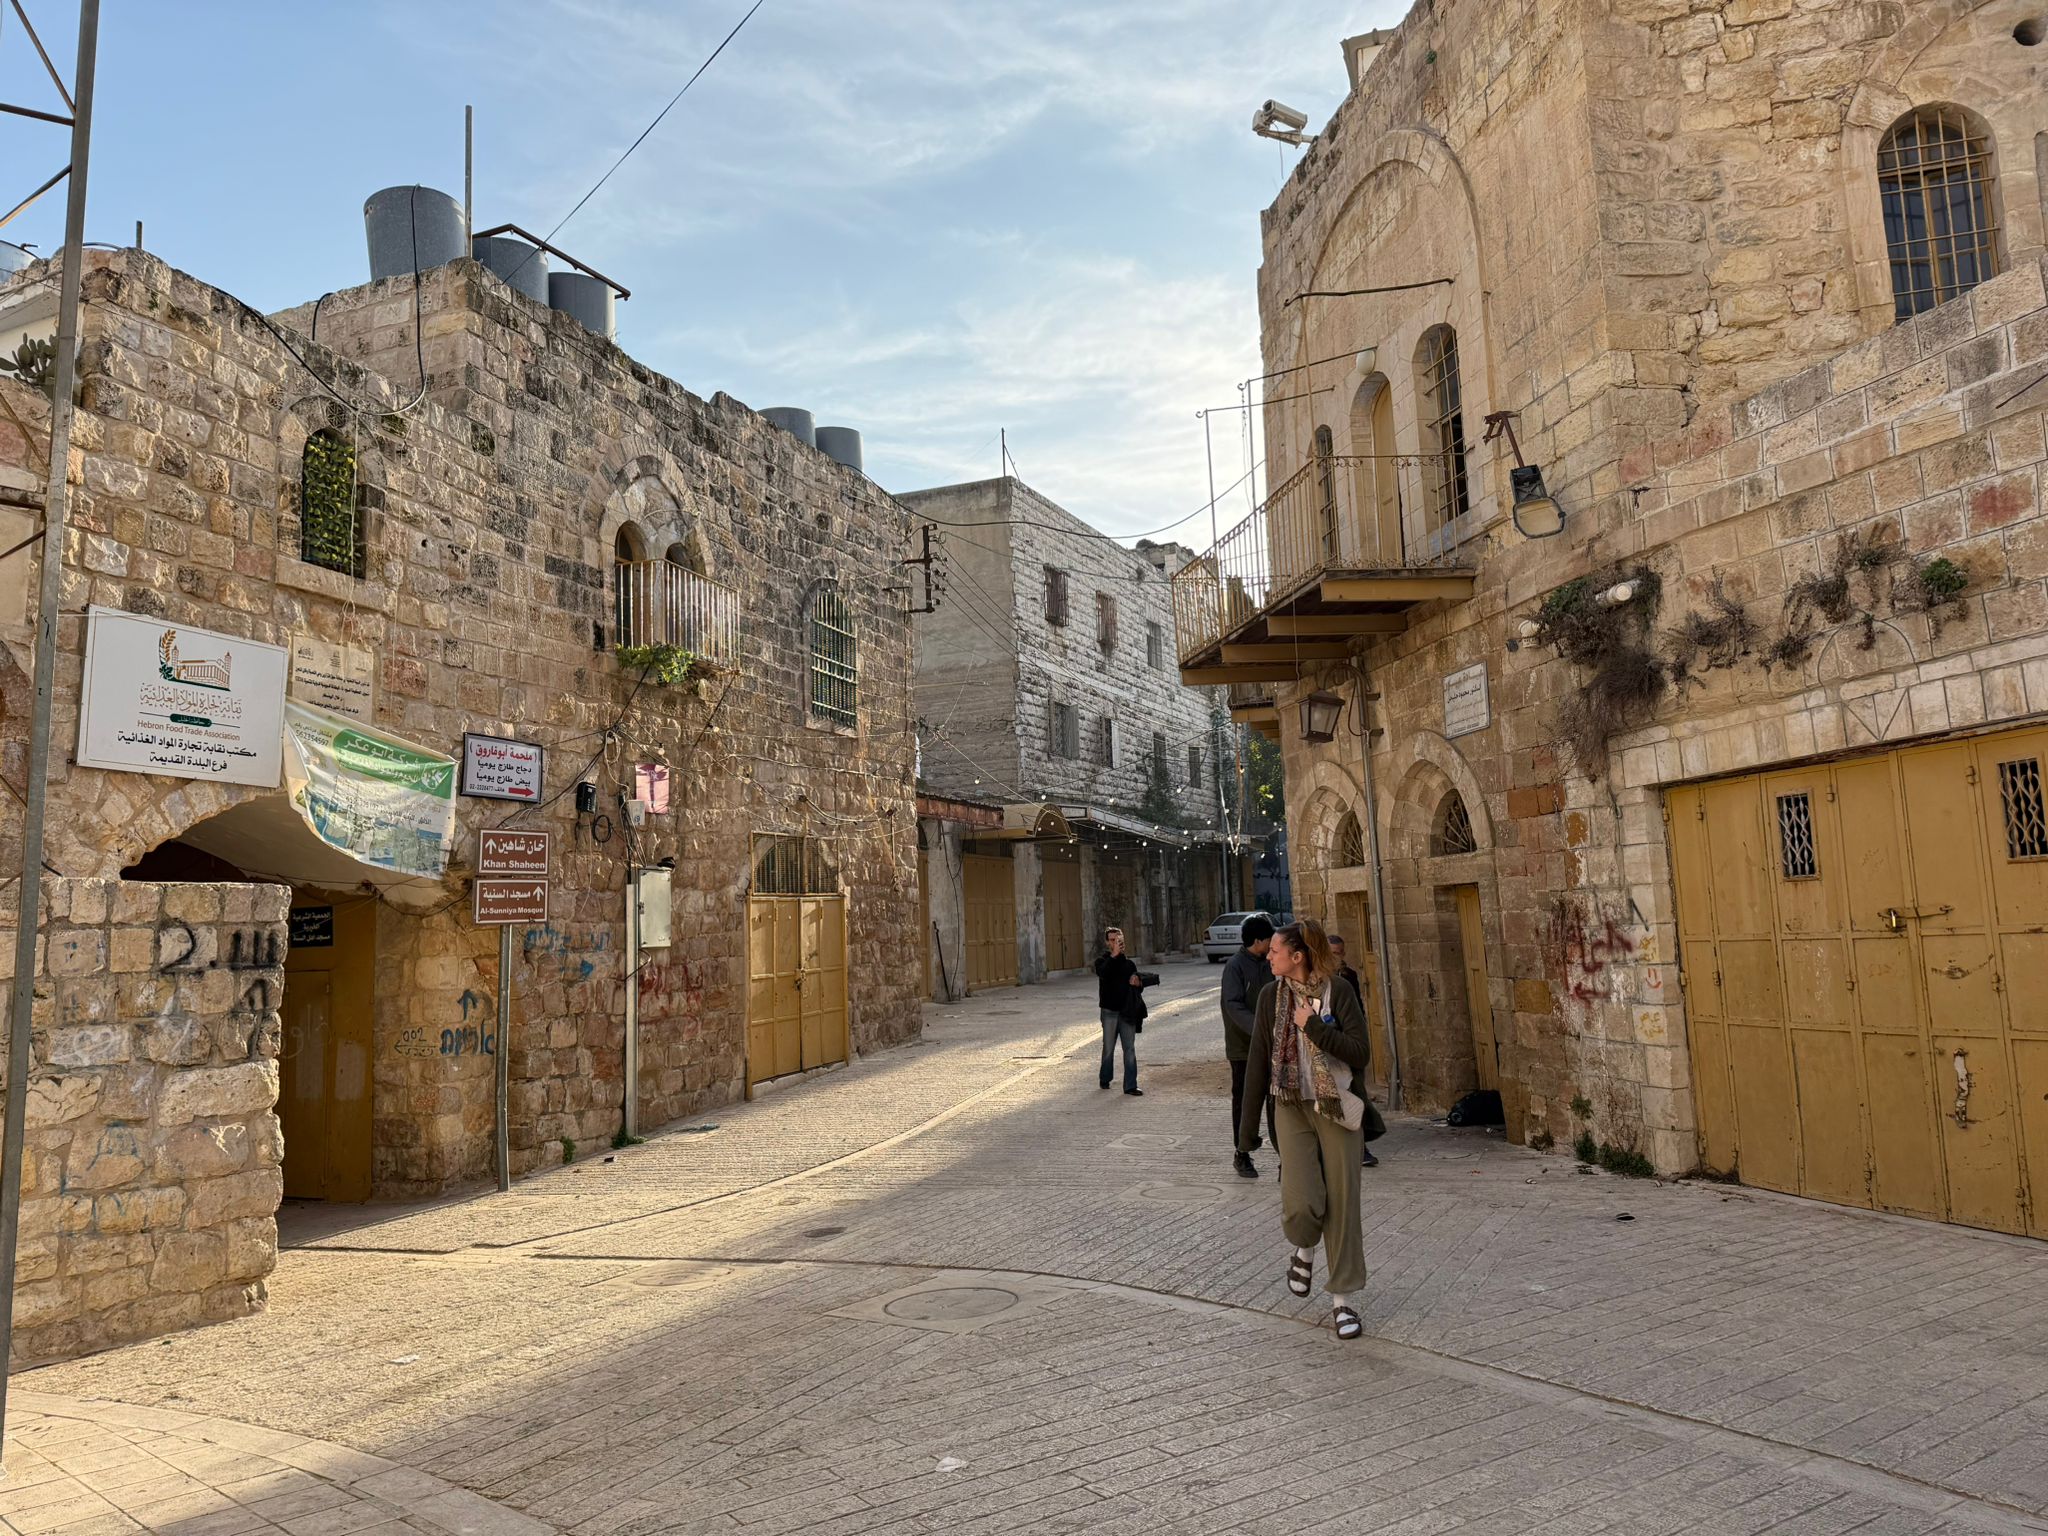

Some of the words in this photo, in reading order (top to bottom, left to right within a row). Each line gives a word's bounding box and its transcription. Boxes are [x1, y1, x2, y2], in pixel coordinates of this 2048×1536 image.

[137, 719, 164, 731] Hebron
[166, 724, 183, 733] Food
[185, 726, 203, 736] Trade
[204, 730, 241, 741] Association
[117, 731, 156, 745] الغذائية
[158, 737, 177, 748] المواد
[178, 738, 202, 751] تجارة
[203, 742, 226, 755] نقابة
[227, 747, 257, 758] مكتب
[150, 752, 186, 766] القديمة
[187, 755, 211, 770] البلدة
[212, 760, 228, 772] فرع
[498, 762, 514, 772] طازج
[516, 765, 532, 774] دجاج
[497, 775, 513, 784] طازج
[515, 778, 531, 787] بيض
[498, 837, 526, 855] شاهين
[526, 839, 545, 855] خان
[483, 859, 507, 868] Khan
[508, 860, 545, 869] Shaheen
[482, 886, 509, 902] السنية
[510, 889, 531, 900] مسجد
[480, 907, 517, 915] Al-Sunniya
[518, 907, 543, 915] Mosque
